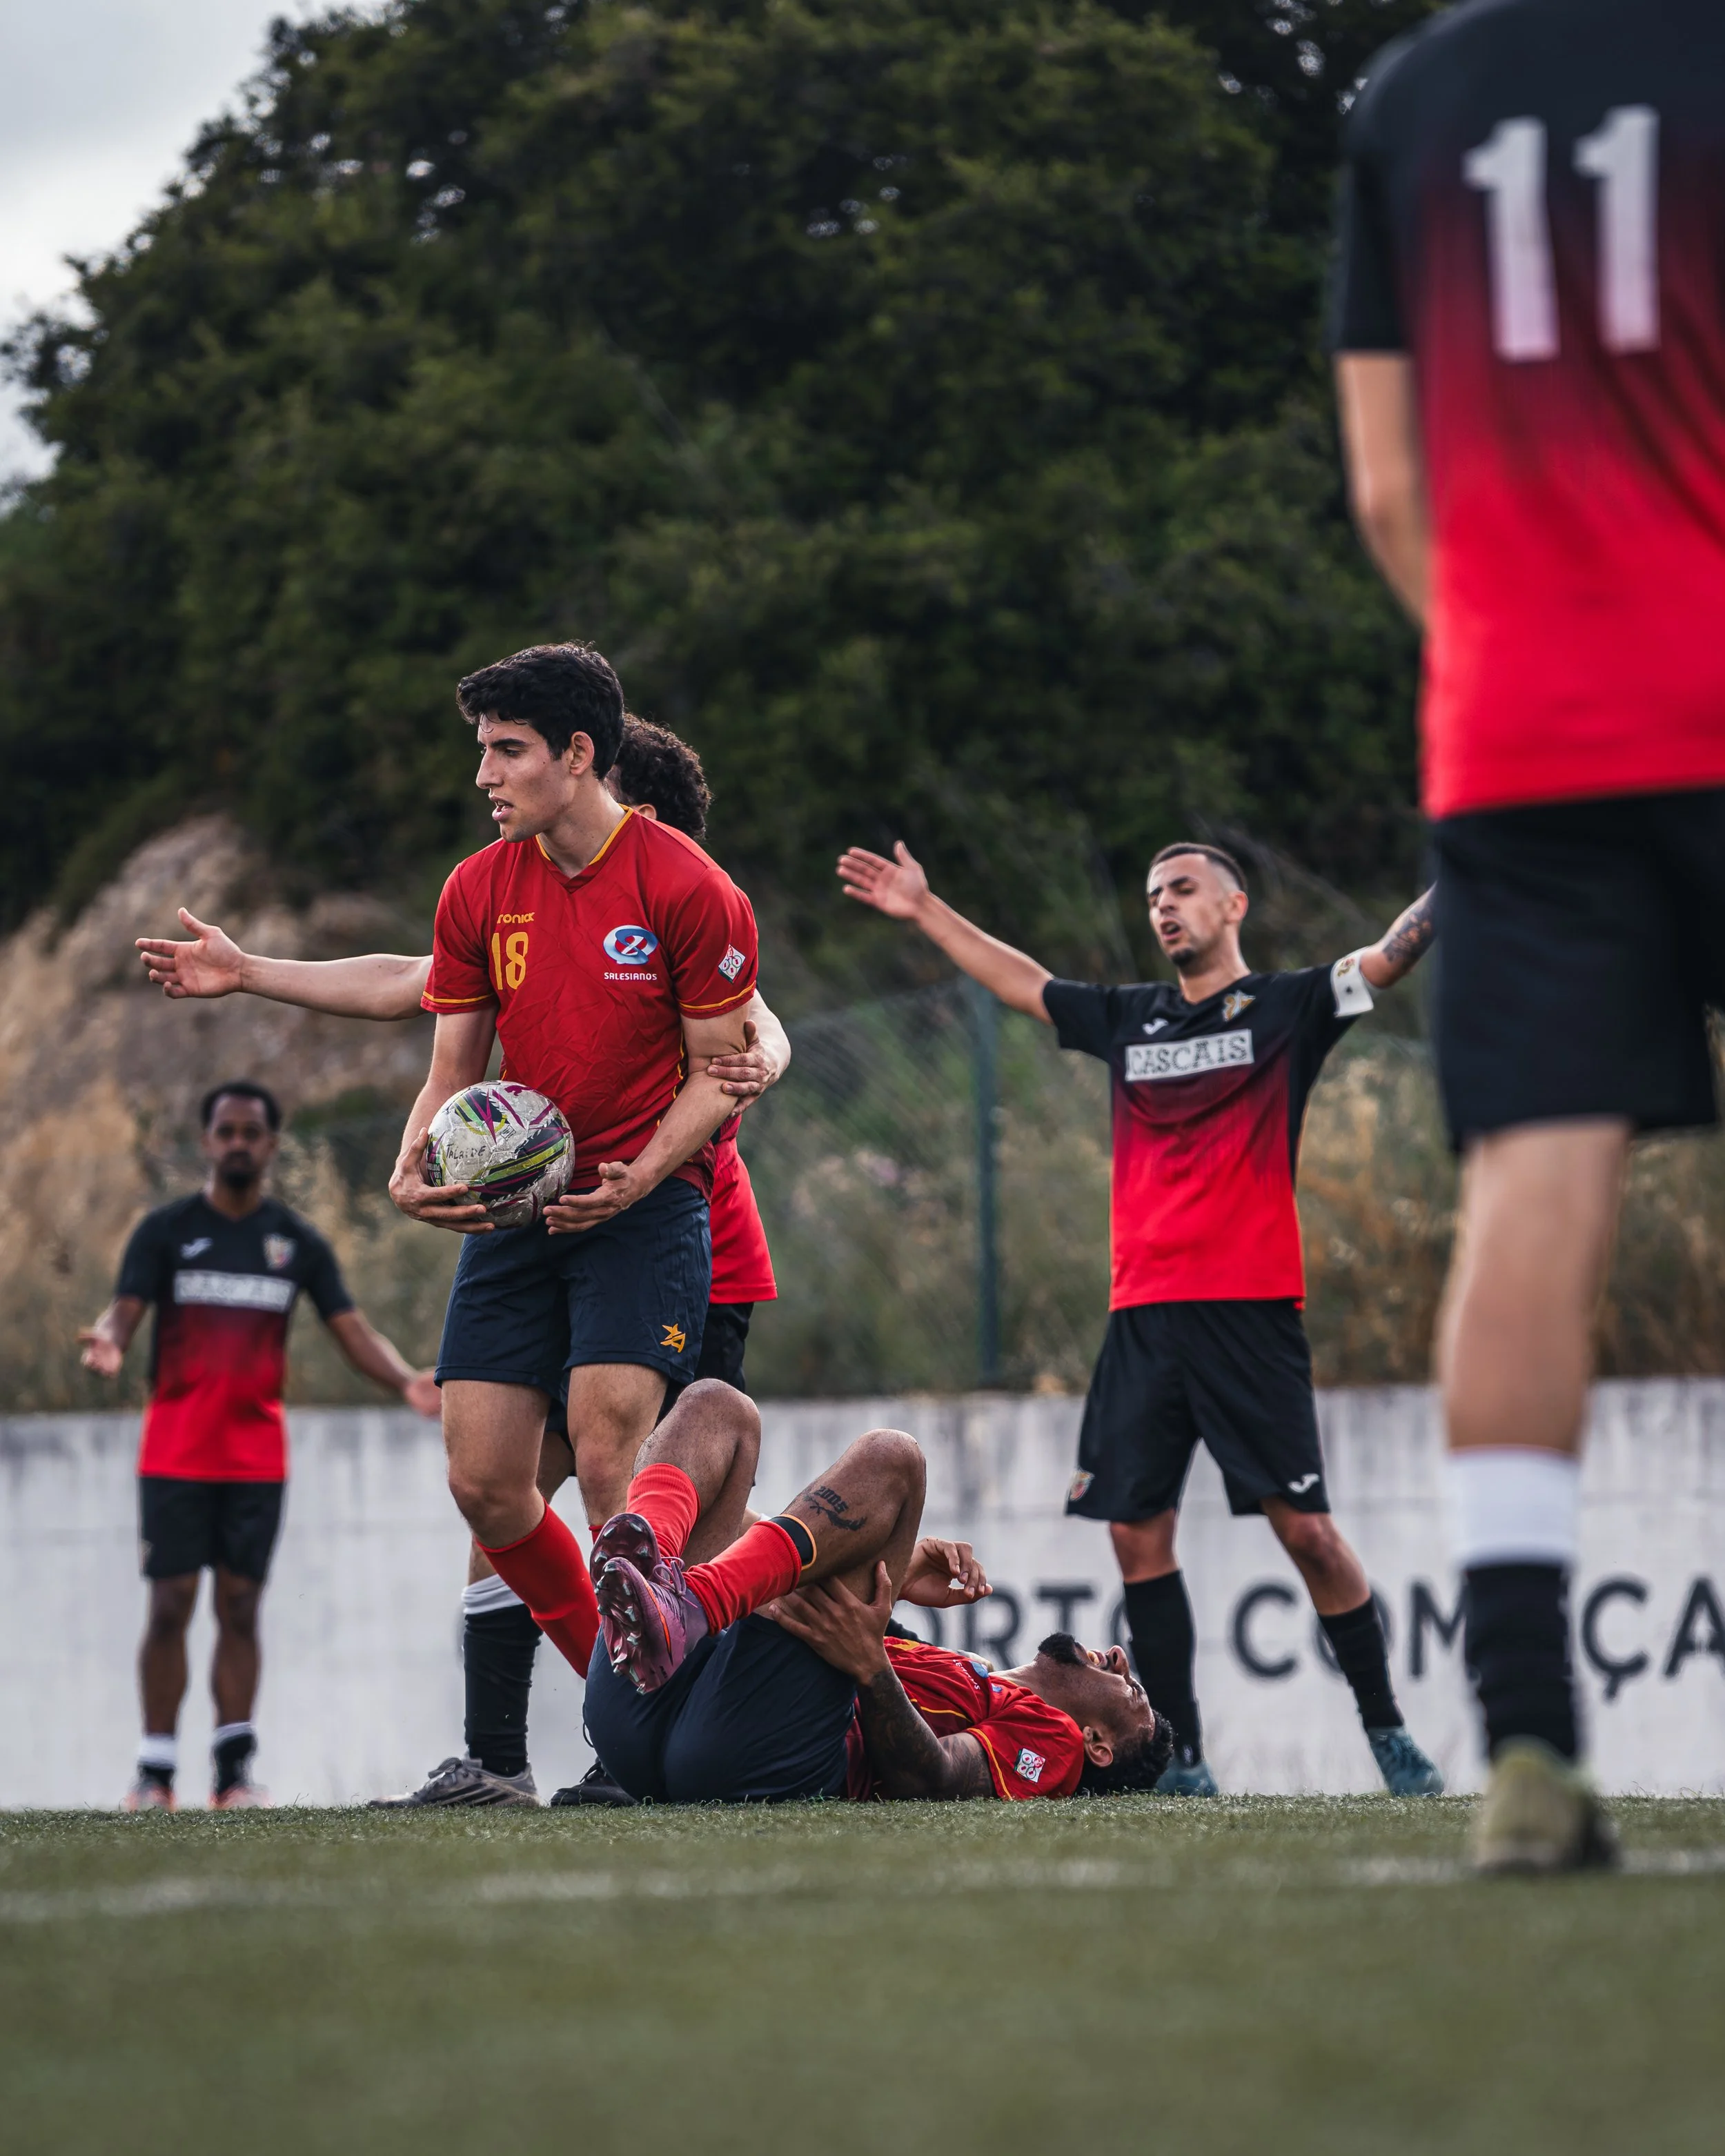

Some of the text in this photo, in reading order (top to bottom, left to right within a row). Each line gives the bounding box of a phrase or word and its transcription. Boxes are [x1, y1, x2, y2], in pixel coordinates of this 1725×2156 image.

[1462, 103, 1661, 362] 11
[492, 932, 529, 990] 18
[604, 972, 658, 980] SALESIANOS
